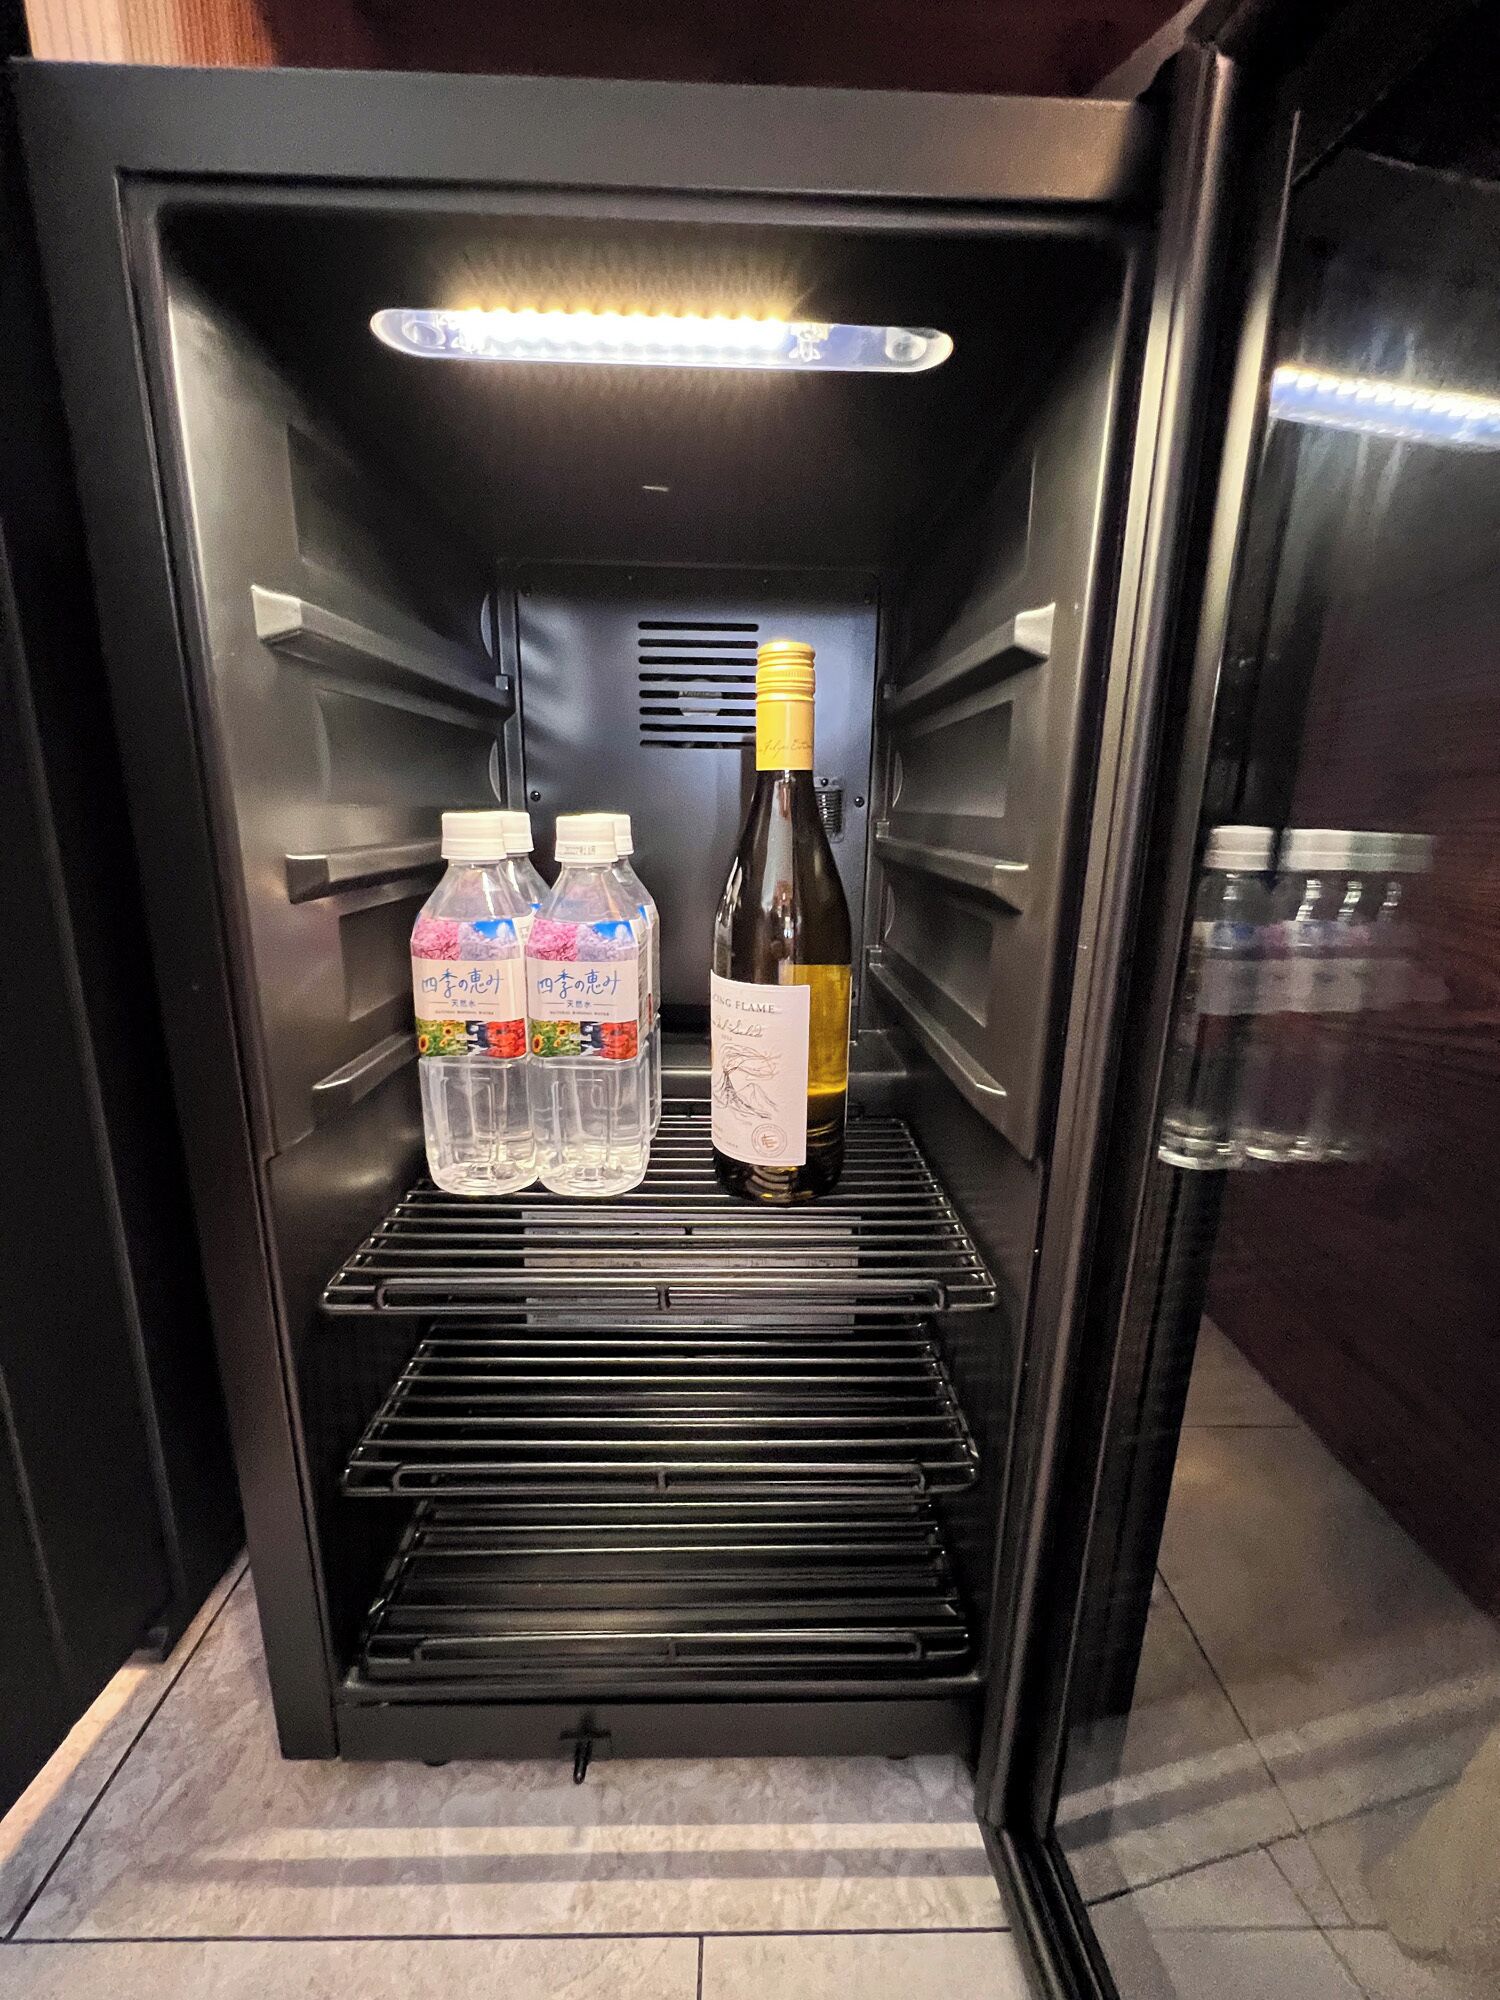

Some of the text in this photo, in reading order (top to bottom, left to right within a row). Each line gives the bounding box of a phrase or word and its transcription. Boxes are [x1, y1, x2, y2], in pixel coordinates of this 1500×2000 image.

[421, 967, 504, 998] 四季の恵み
[537, 968, 620, 999] 四季の恵み
[735, 1000, 776, 1014] FLAME
